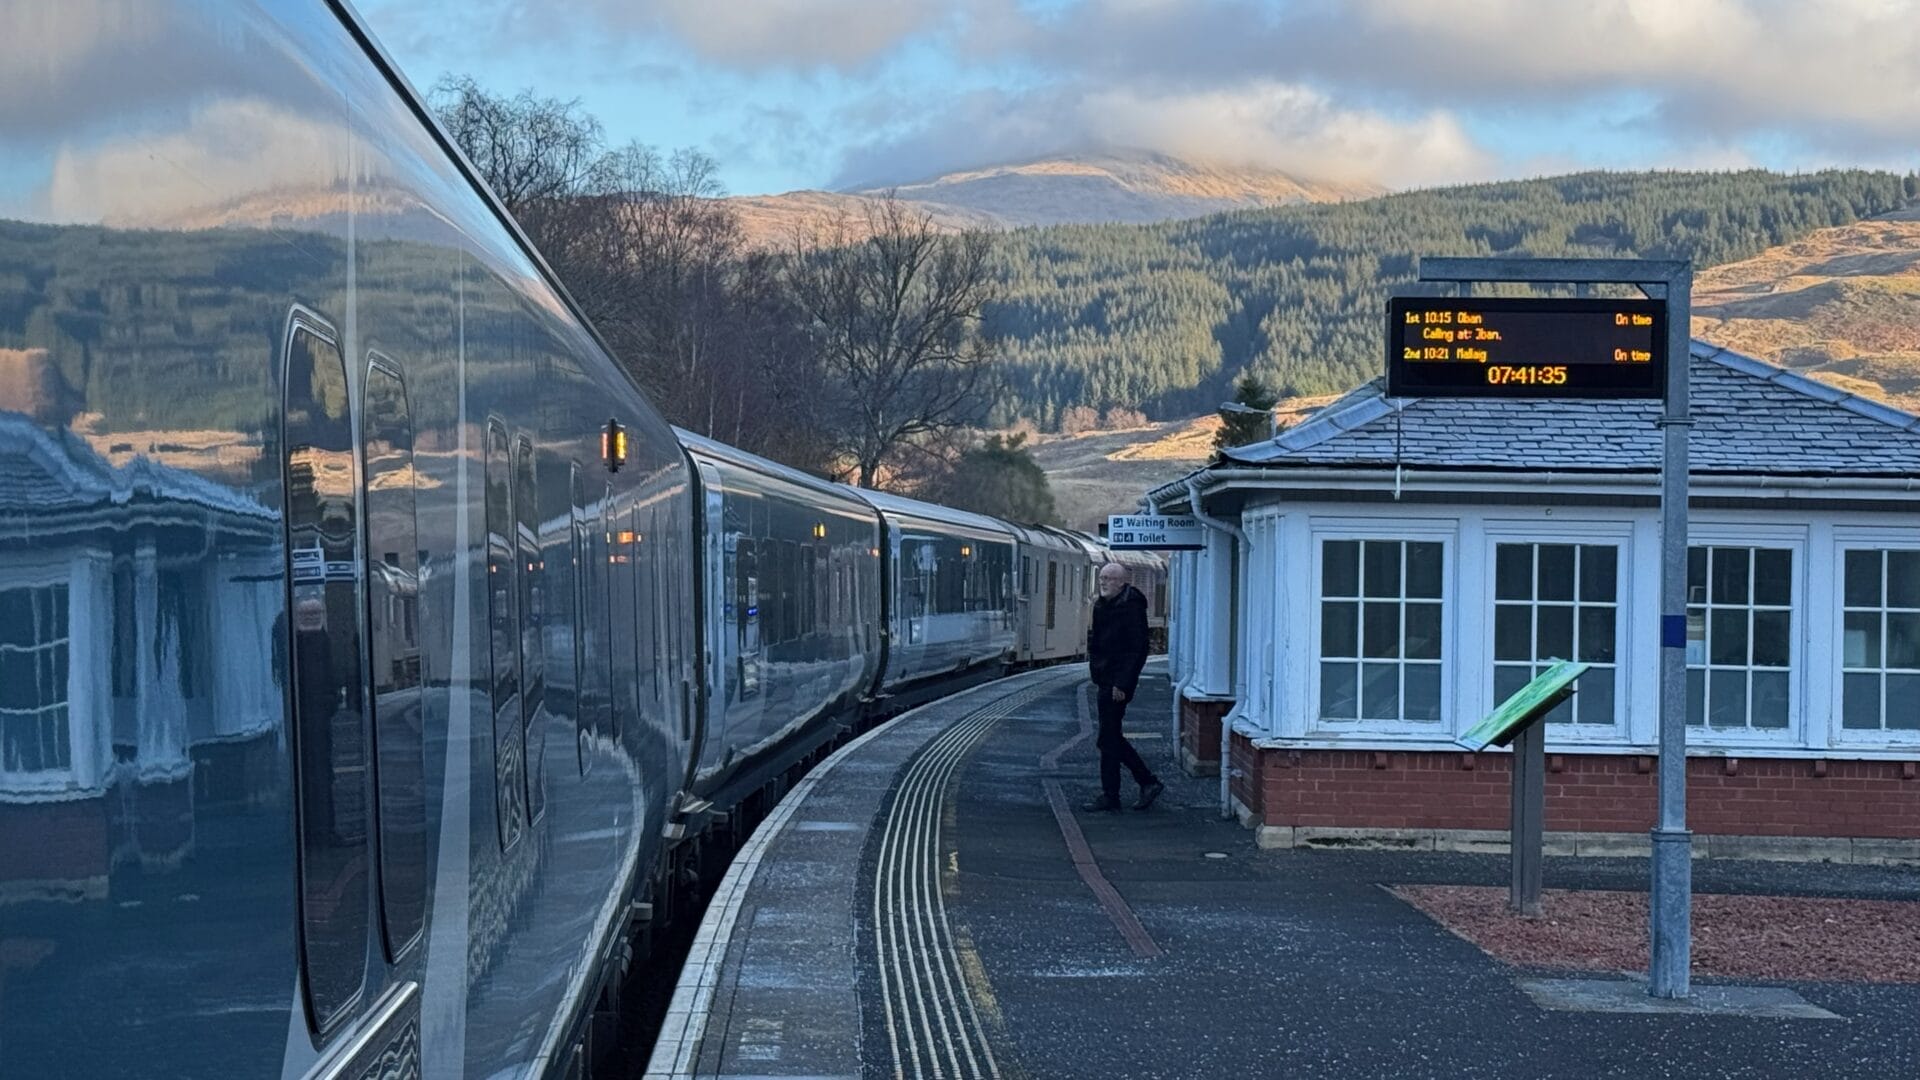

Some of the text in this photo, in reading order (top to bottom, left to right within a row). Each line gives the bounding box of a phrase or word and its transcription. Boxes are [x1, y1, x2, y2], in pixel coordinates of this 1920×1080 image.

[1405, 311, 1482, 324] 1st 10:15 Oban
[1615, 313, 1653, 326] On time
[1423, 327, 1454, 342] Calling
[1404, 347, 1488, 363] 2nd 10:21 Mallaig
[1614, 349, 1652, 362] On time
[1487, 366, 1567, 384] 07:41:35
[1126, 517, 1195, 529] Waiting Room
[1138, 533, 1167, 543] Toilet
